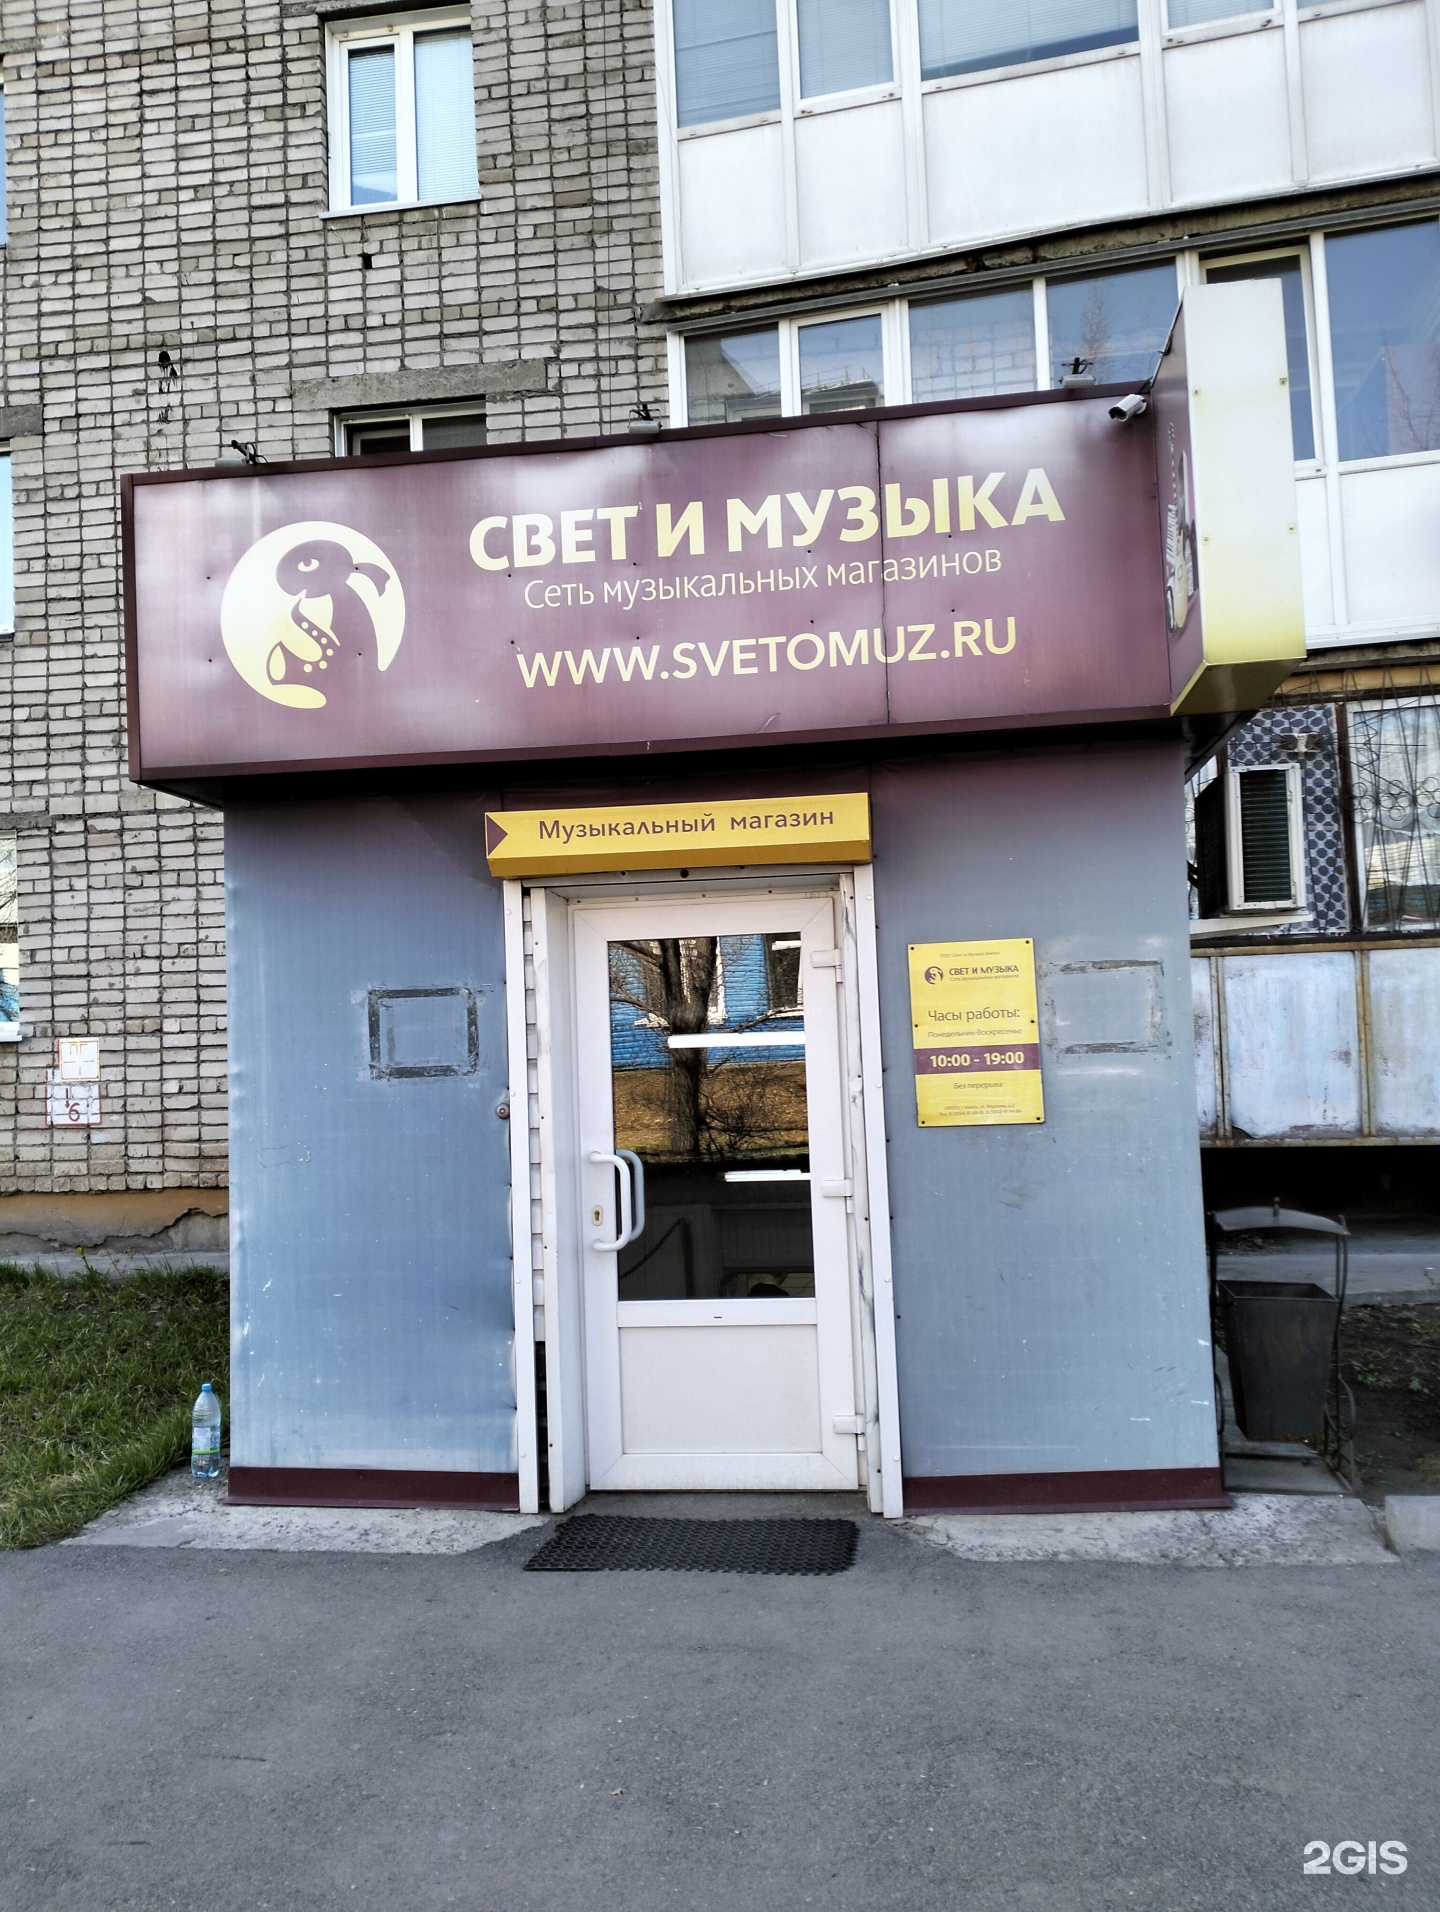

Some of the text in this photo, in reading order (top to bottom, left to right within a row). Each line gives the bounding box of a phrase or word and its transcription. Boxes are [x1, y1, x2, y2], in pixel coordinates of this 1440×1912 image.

[469, 467, 1066, 571] СВЕТ И МУЗЫКА
[523, 548, 1003, 611] Сеть музыкальных магазинов
[516, 615, 1017, 688] WWW.SVETOMUZ.RU
[538, 811, 834, 845] Музыкальный магазин
[949, 964, 1019, 976] СВЕТ И МУЗЫКА
[928, 1007, 1020, 1023] Часы работы:
[929, 1053, 971, 1068] 10:00
[983, 1051, 1025, 1065] 19:00
[953, 1081, 1003, 1090] Без перерыва
[68, 1102, 80, 1122] 6
